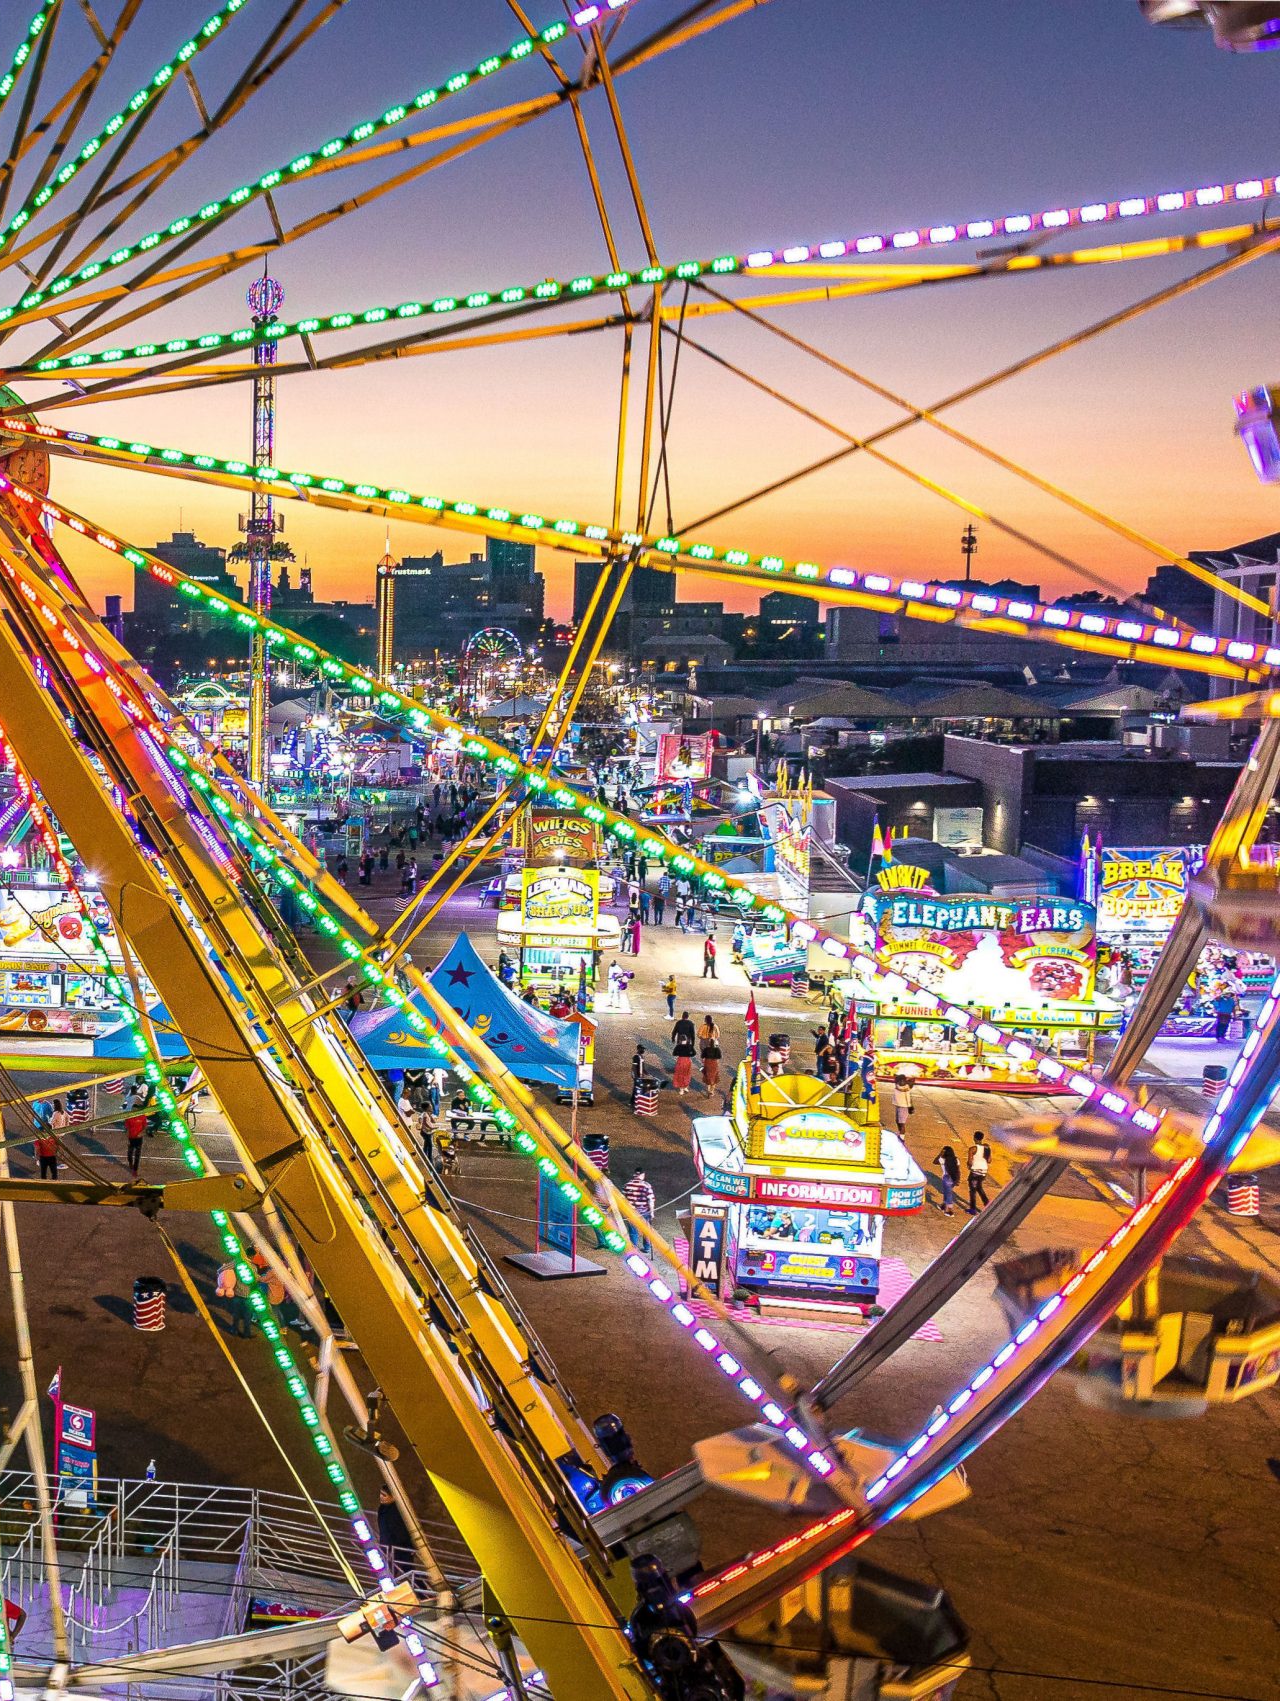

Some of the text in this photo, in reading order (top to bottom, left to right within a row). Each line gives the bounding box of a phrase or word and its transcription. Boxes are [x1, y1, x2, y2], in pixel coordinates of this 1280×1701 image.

[391, 567, 432, 576] Trustmark
[539, 836, 584, 849] FRIES
[1103, 861, 1184, 888] BREAK
[1135, 881, 1150, 898] A
[1102, 894, 1184, 918] BOTTLE
[892, 901, 1084, 933] ELEPHANT EARS
[900, 1005, 932, 1017] FUNNEL
[785, 1125, 846, 1142] Guest
[715, 1173, 731, 1185] CAN
[732, 1177, 746, 1187] WE
[761, 1182, 874, 1204] INFORMATION
[701, 1208, 719, 1216] ATM
[695, 1221, 718, 1280] ATM
